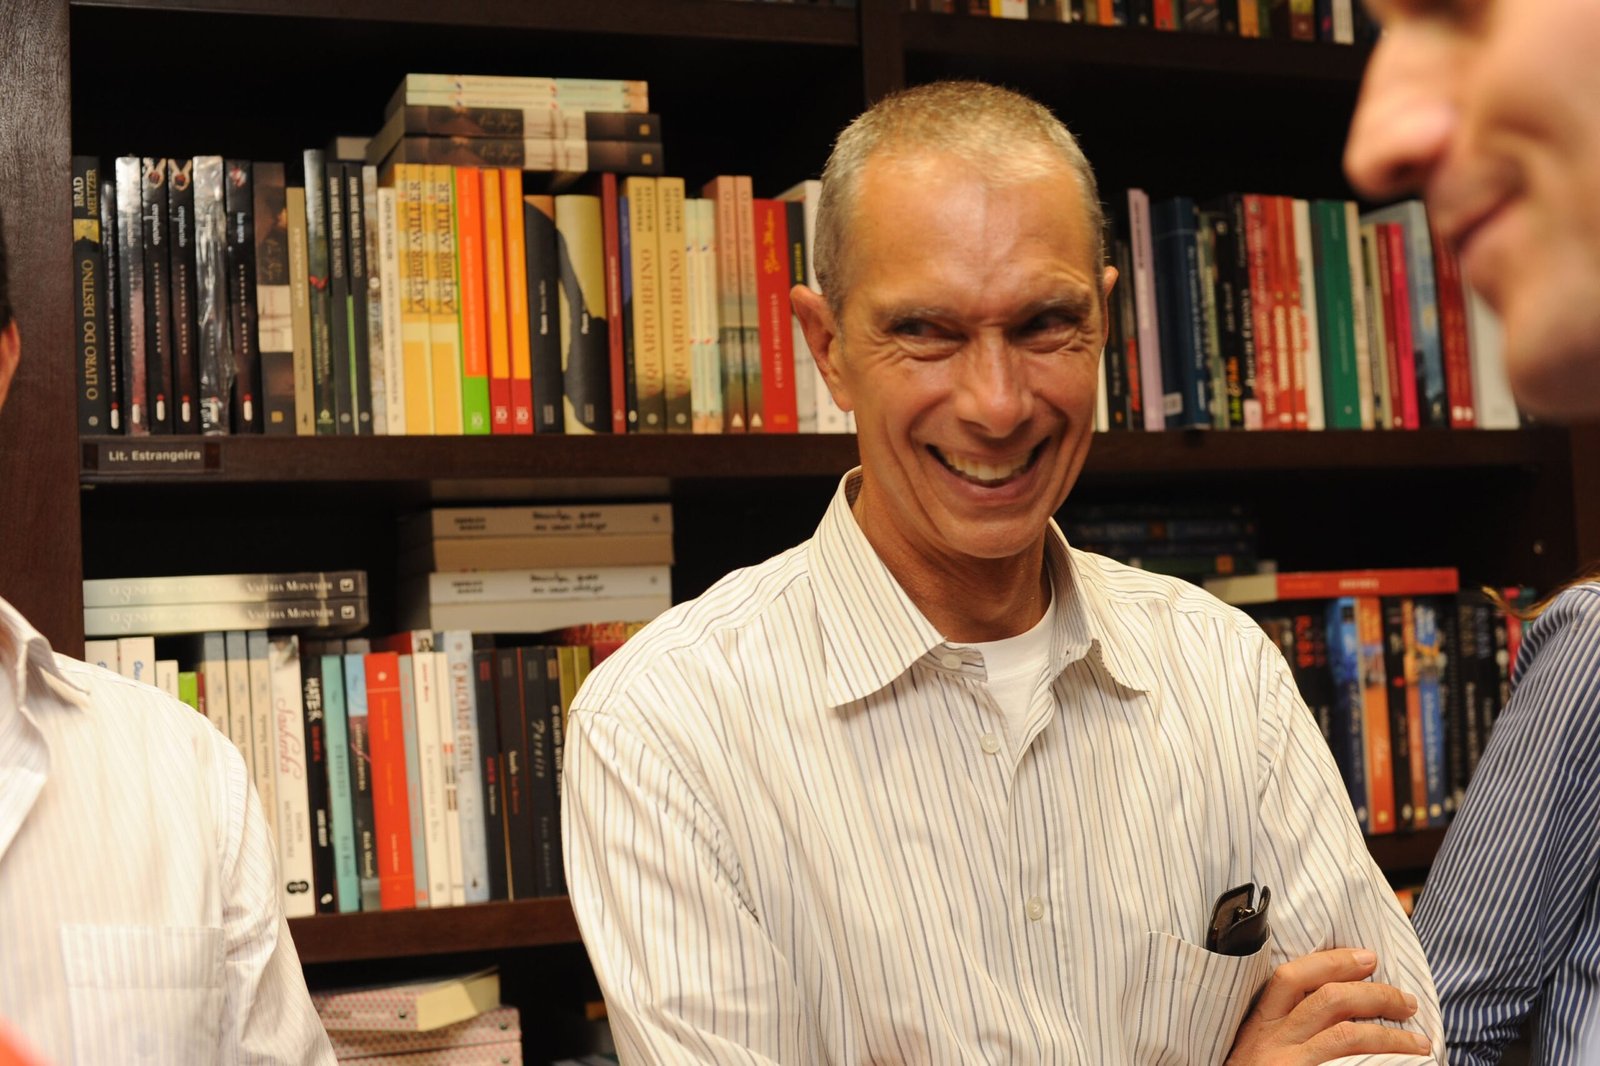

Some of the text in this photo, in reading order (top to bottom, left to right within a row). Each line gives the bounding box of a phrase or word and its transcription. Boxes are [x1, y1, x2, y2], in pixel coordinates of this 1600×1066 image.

[73, 176, 84, 207] BRAD
[86, 168, 98, 216] MELTZER
[350, 176, 360, 193] JUAN
[145, 204, 161, 246] crepúsculo
[172, 205, 188, 248] crepúsculo
[407, 180, 428, 310] ARTHUR MILLER
[436, 183, 457, 312] ARTHUR MILLER
[640, 248, 655, 305] REINO
[669, 249, 683, 305] REINO
[81, 259, 98, 400] O LIVRO DO DESTINO
[642, 309, 659, 380] QUARTO
[671, 309, 687, 380] QUARTO
[108, 450, 201, 463] Lit. Estrangeira
[305, 677, 322, 723] HATER
[275, 697, 303, 781] Sashenka
